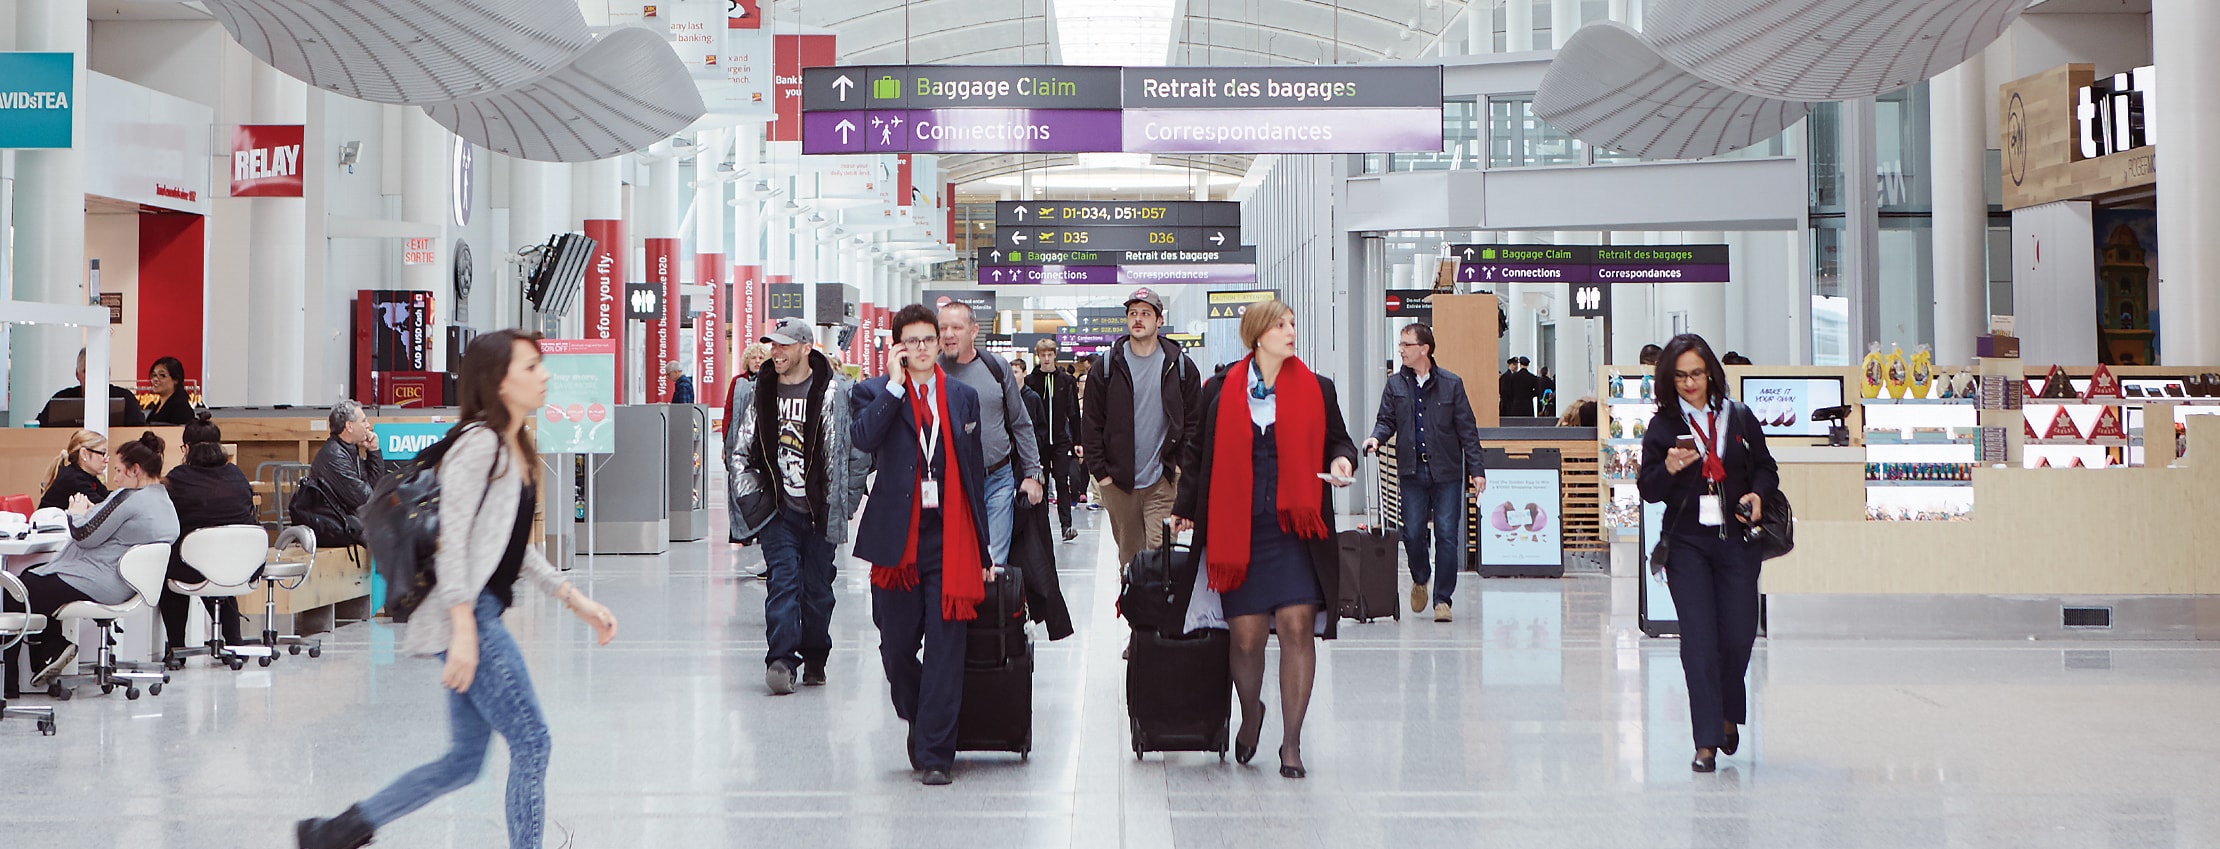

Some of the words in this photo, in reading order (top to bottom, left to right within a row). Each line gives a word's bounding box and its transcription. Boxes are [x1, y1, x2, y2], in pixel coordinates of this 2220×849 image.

[670, 24, 686, 32] any
[678, 34, 714, 44] banking.
[776, 76, 797, 84] Bank
[917, 78, 1010, 100] Baggage
[1017, 77, 1076, 96] Claim
[1144, 78, 1216, 98] Retrait
[1224, 78, 1260, 97] des
[1268, 79, 1356, 100] bagages
[916, 121, 1050, 140] Connections
[1145, 122, 1332, 144] Correspondances
[235, 144, 300, 181] RELAY
[1063, 208, 1110, 220] D1-D34,
[1115, 208, 1166, 219] D51-D57
[1064, 232, 1088, 243] D35
[1149, 232, 1174, 243] D36
[410, 238, 429, 250] EXIT
[405, 252, 434, 263] SORTIE
[1028, 251, 1069, 262] Baggage
[1071, 251, 1097, 261] Claim
[1126, 251, 1158, 261] Retrait
[1161, 251, 1177, 261] des
[1180, 251, 1219, 262] bagages
[1502, 250, 1543, 260] Baggage
[1546, 250, 1571, 259] Claim
[1599, 250, 1631, 259] Retrait
[1634, 250, 1650, 259] des
[1653, 250, 1692, 260] bagages
[597, 252, 614, 274] fly.
[659, 254, 667, 275] D20.
[1028, 271, 1088, 280] Connections
[1127, 270, 1209, 281] Correspondances
[1502, 268, 1561, 278] Connections
[1599, 268, 1681, 279] Correspondances
[600, 277, 613, 301] you
[597, 304, 610, 338] efore
[658, 328, 667, 358] branch
[703, 320, 713, 355] before
[658, 359, 667, 374] our
[703, 356, 713, 383] Bank
[658, 375, 667, 396] Visit
[395, 386, 422, 398] CIBC
[389, 435, 446, 452] DAVID
